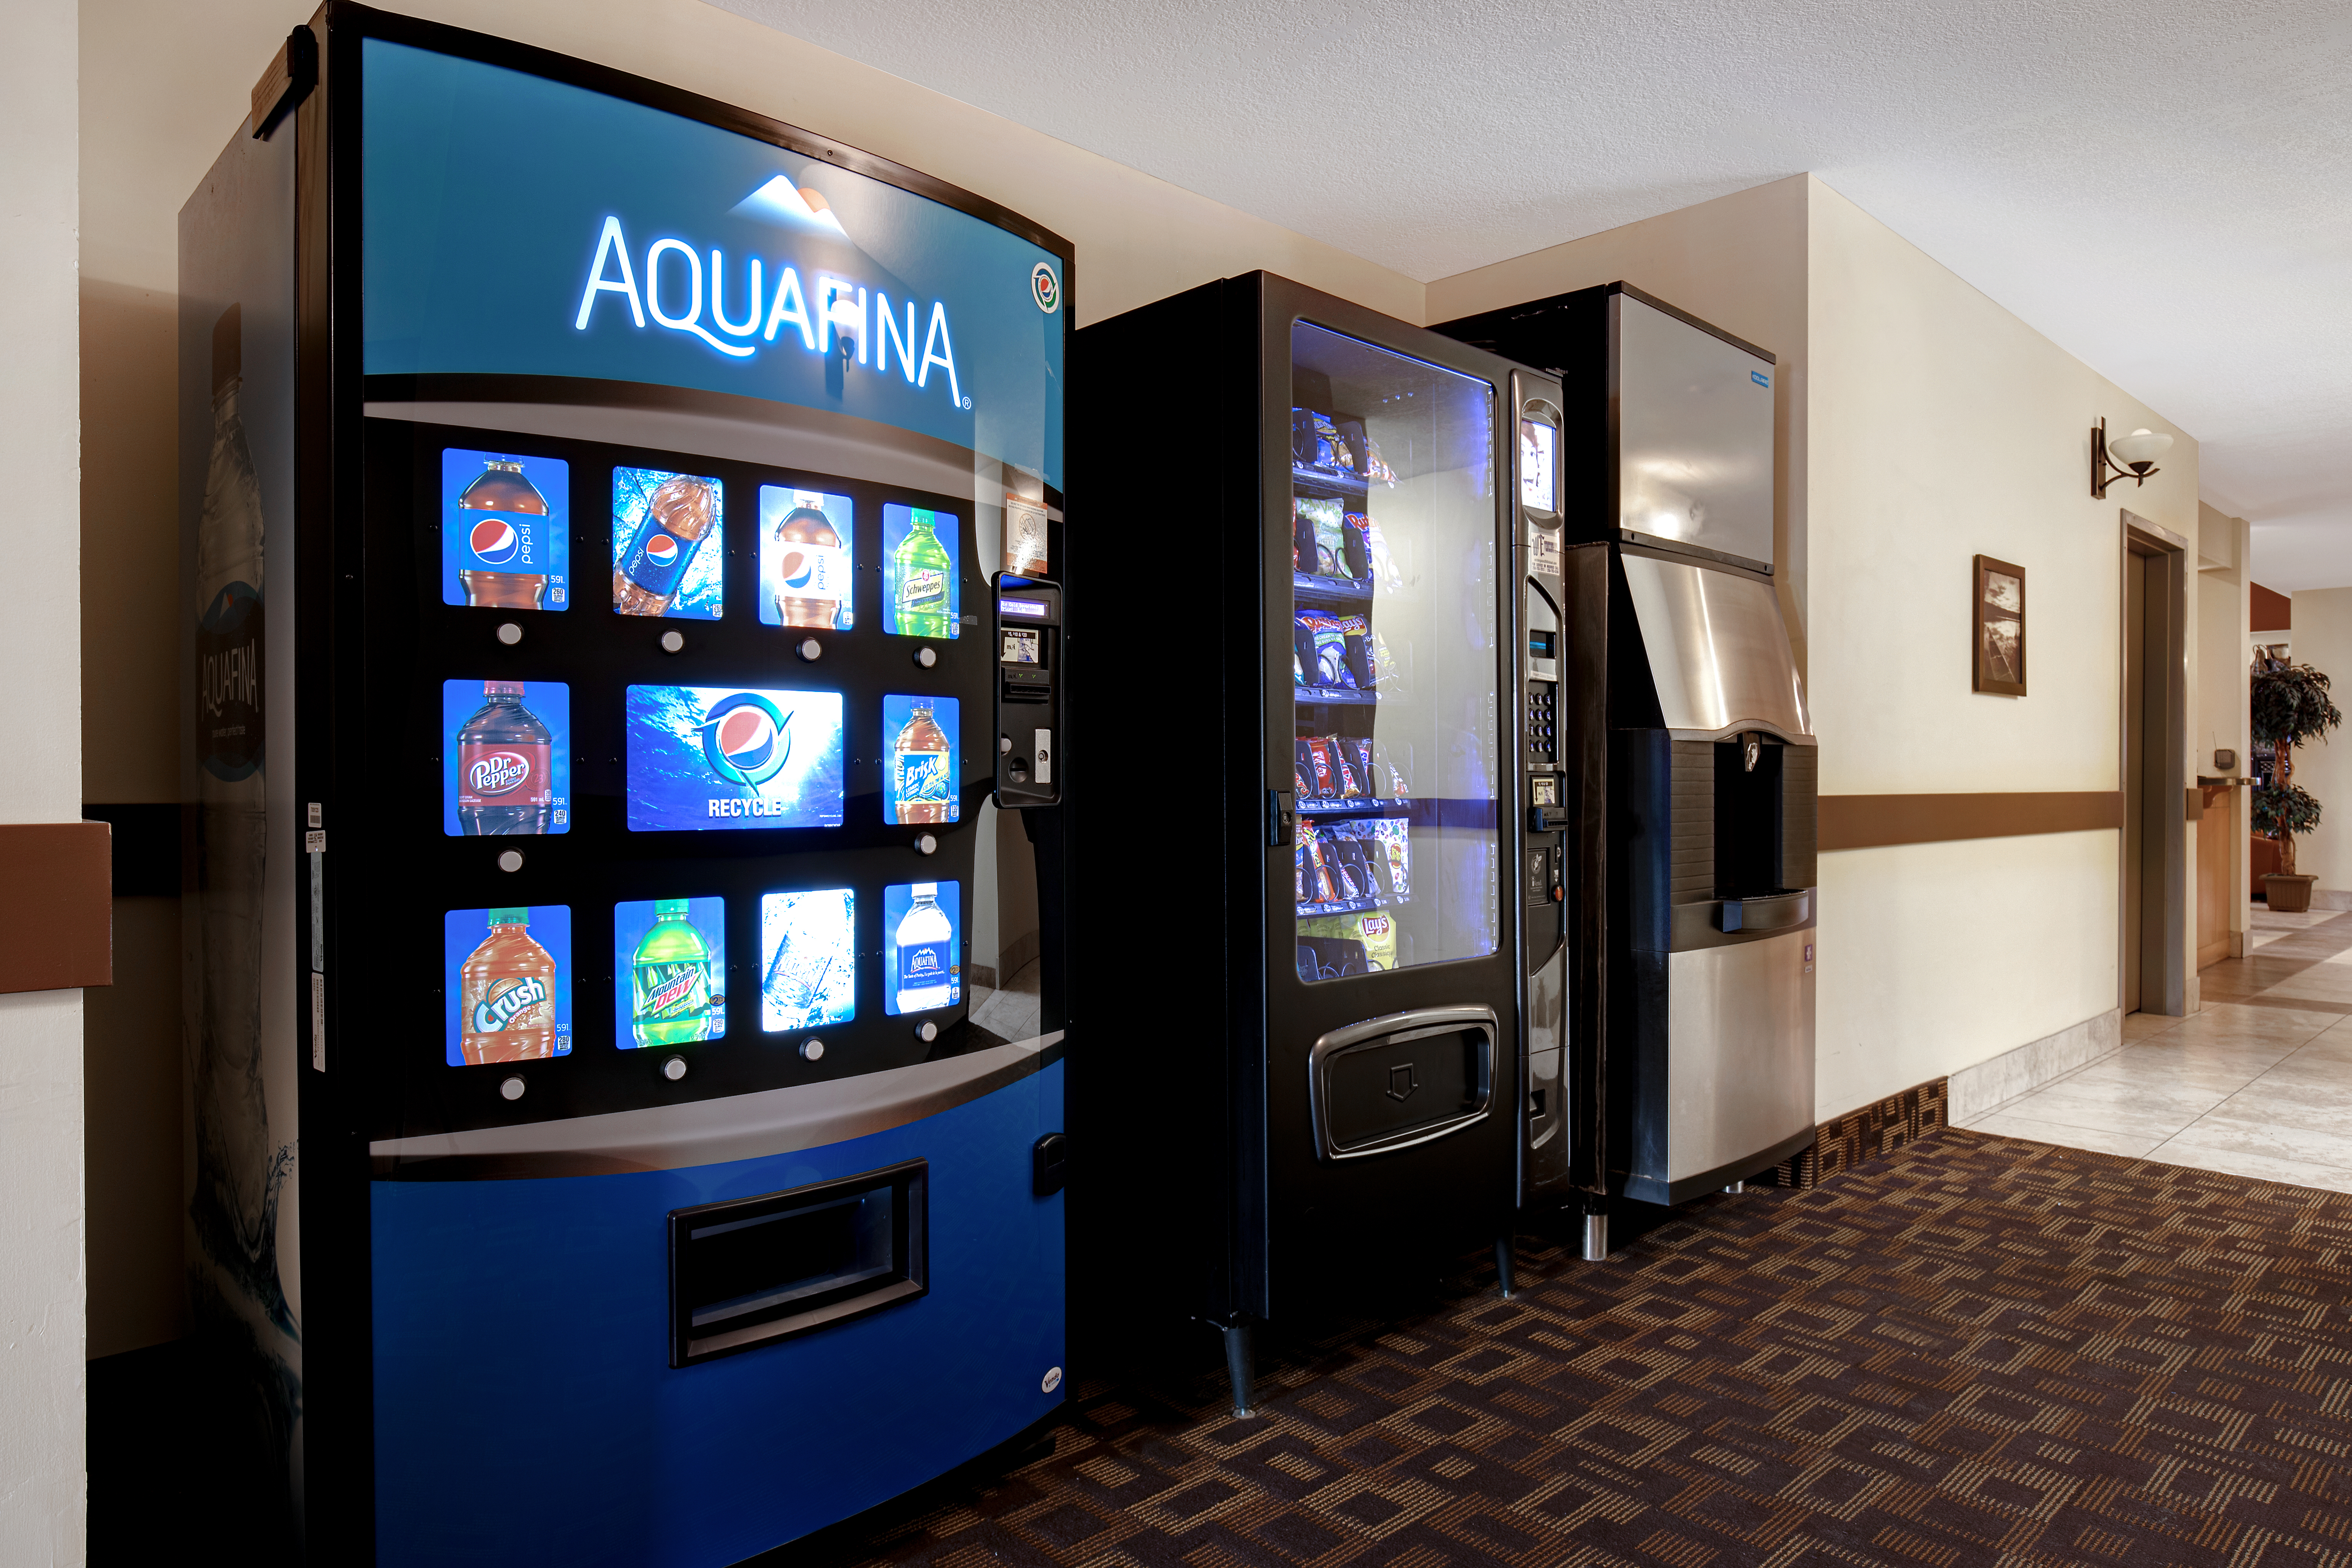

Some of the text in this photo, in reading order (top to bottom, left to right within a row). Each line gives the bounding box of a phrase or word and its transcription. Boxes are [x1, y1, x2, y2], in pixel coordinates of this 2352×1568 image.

[575, 215, 961, 408] AQUAFINA
[519, 523, 533, 565] pepsi
[628, 547, 643, 576] pepsi
[816, 555, 825, 590] pepsi
[906, 581, 940, 598] Schweppes
[1342, 617, 1362, 632] ay's
[202, 638, 258, 721] AQUAFINA
[489, 757, 511, 773] Dr
[905, 757, 937, 787] Brisk
[476, 761, 525, 790] Pepper
[534, 774, 543, 783] 23
[906, 783, 919, 792] LEMON
[553, 797, 565, 805] 591
[709, 798, 781, 818] RECYCLE
[1364, 916, 1387, 935] Lay's
[911, 956, 938, 972] AQUAFINA
[647, 968, 694, 1003] Mountain
[476, 977, 545, 1033] Crush
[509, 1006, 531, 1023] orange
[557, 1023, 568, 1032] 591
[1044, 1373, 1059, 1388] Vendo
